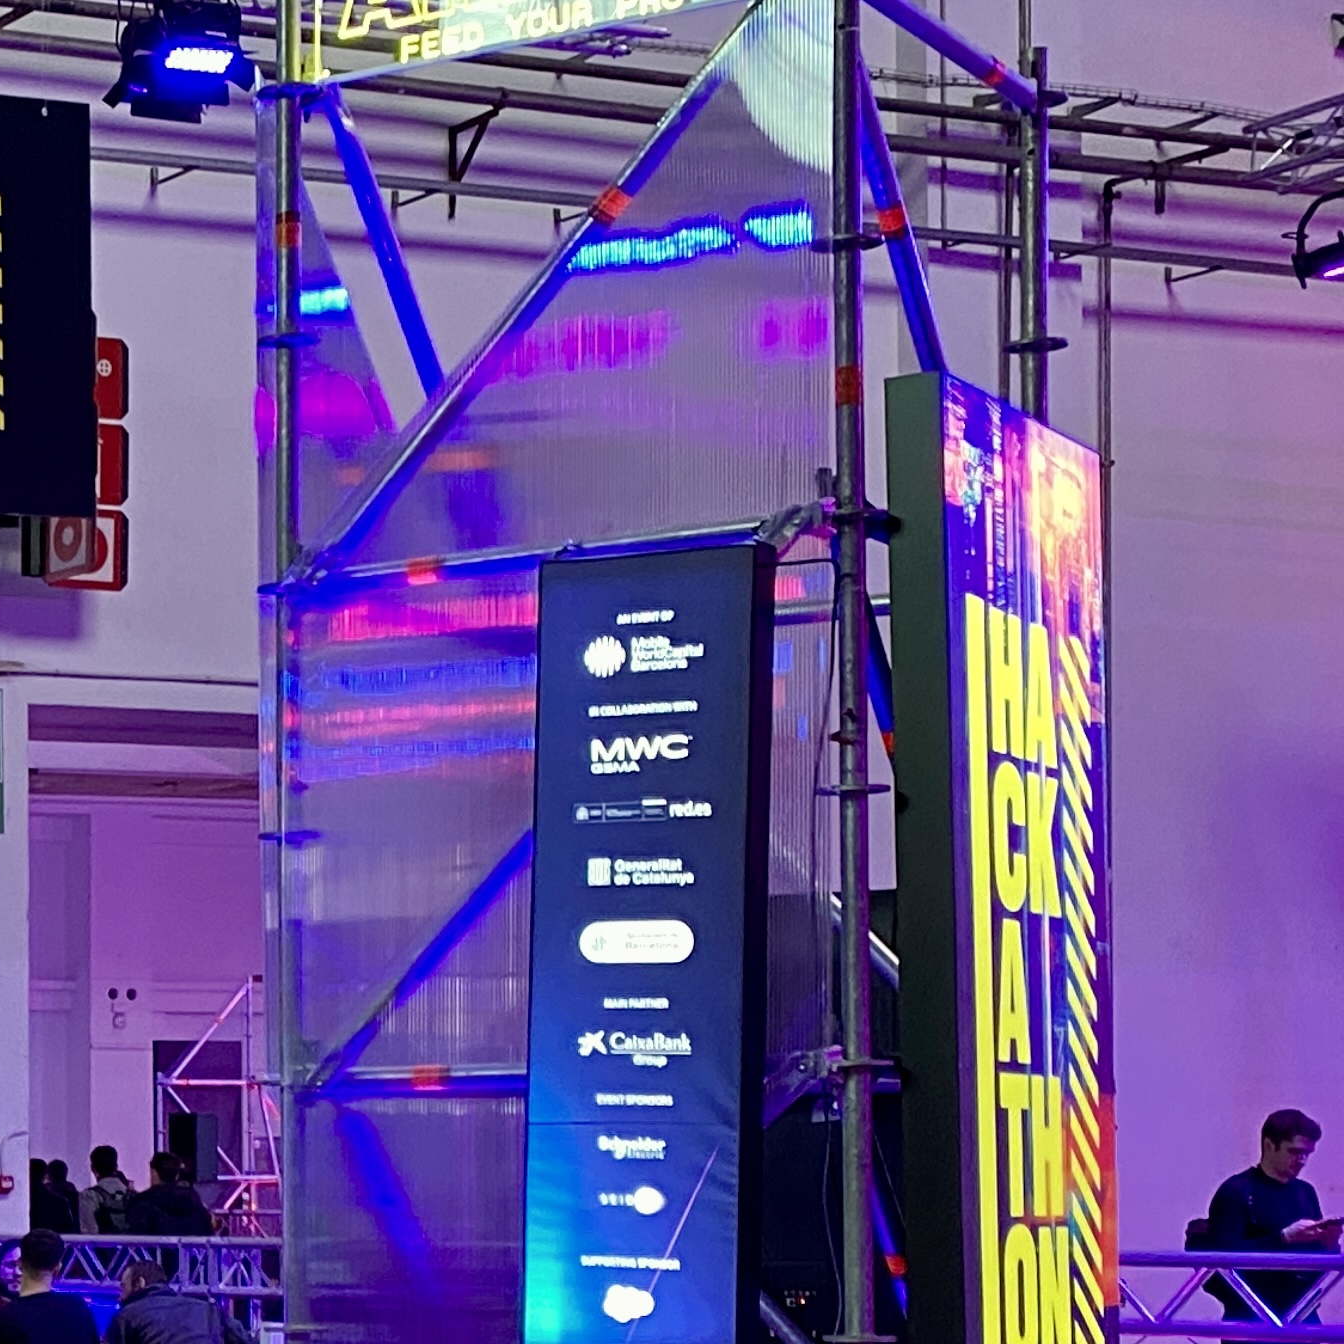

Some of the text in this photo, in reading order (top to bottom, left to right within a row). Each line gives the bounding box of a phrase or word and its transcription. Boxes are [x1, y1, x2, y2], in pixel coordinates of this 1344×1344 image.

[400, 20, 485, 64] FEED
[507, 3, 593, 41] YOUR
[591, 734, 689, 762] MWC
[614, 858, 683, 873] Generalitat
[632, 871, 695, 887] Catalunya
[609, 1031, 691, 1051] CaixaBank
